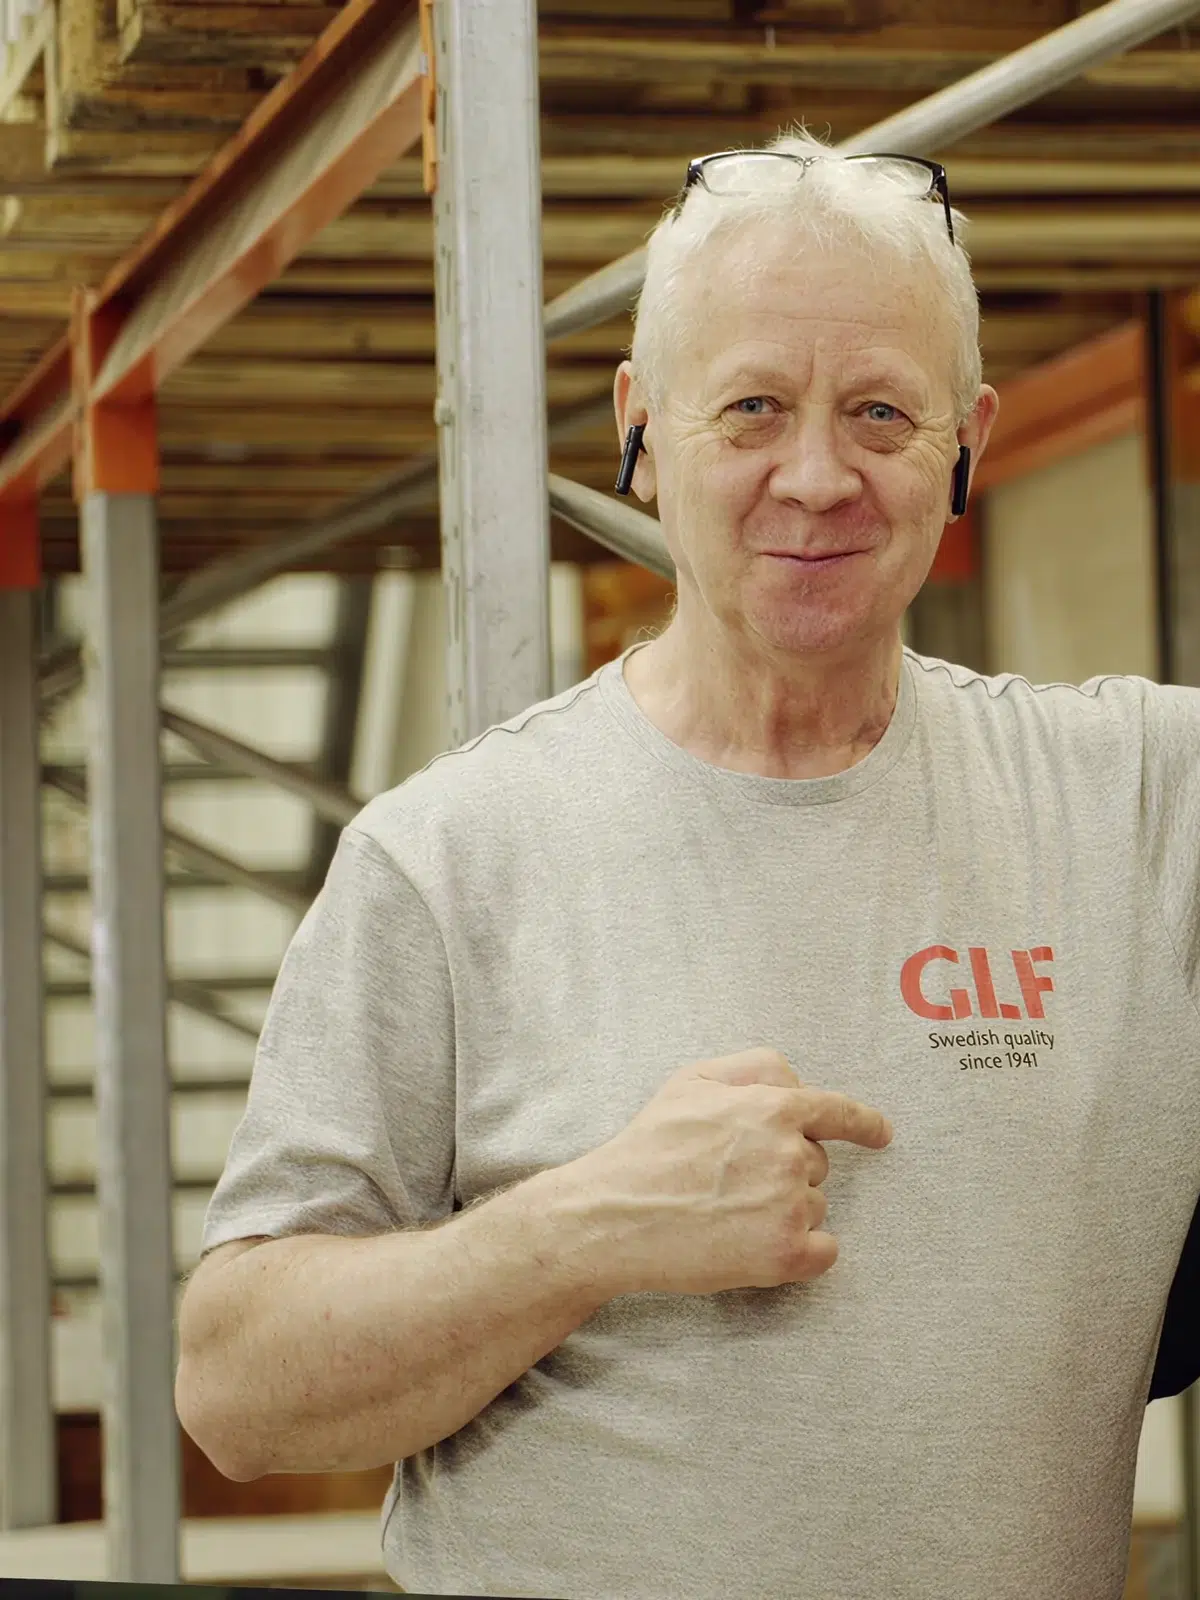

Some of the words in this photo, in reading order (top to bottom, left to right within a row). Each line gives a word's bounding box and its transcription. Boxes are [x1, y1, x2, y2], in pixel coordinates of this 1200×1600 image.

[900, 945, 1054, 1020] GLF
[928, 1029, 1000, 1049] Swedish
[1004, 1030, 1055, 1050] quality
[959, 1054, 1002, 1070] since
[1005, 1052, 1038, 1068] 1941
